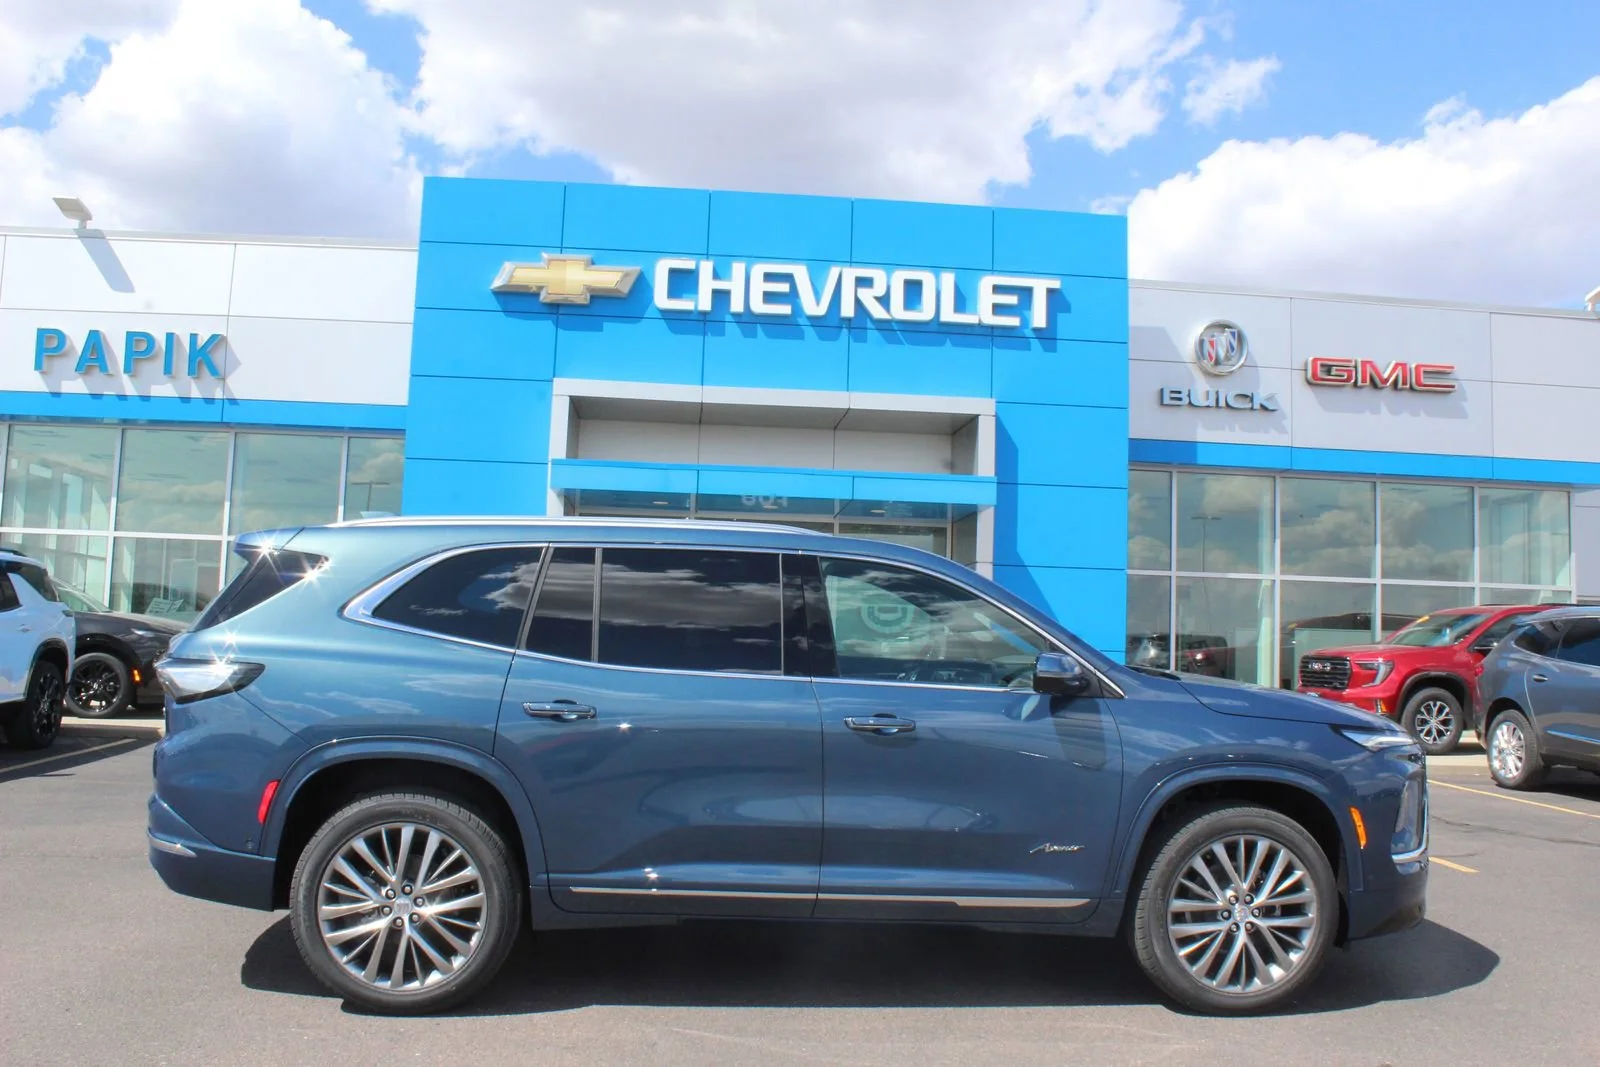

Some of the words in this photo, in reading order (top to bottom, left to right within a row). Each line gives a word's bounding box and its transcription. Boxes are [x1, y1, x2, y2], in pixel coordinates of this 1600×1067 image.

[654, 258, 1061, 328] CHEVROLET
[34, 327, 227, 379] PAPIK
[1306, 356, 1457, 393] GMC
[1160, 386, 1279, 412] BUICK
